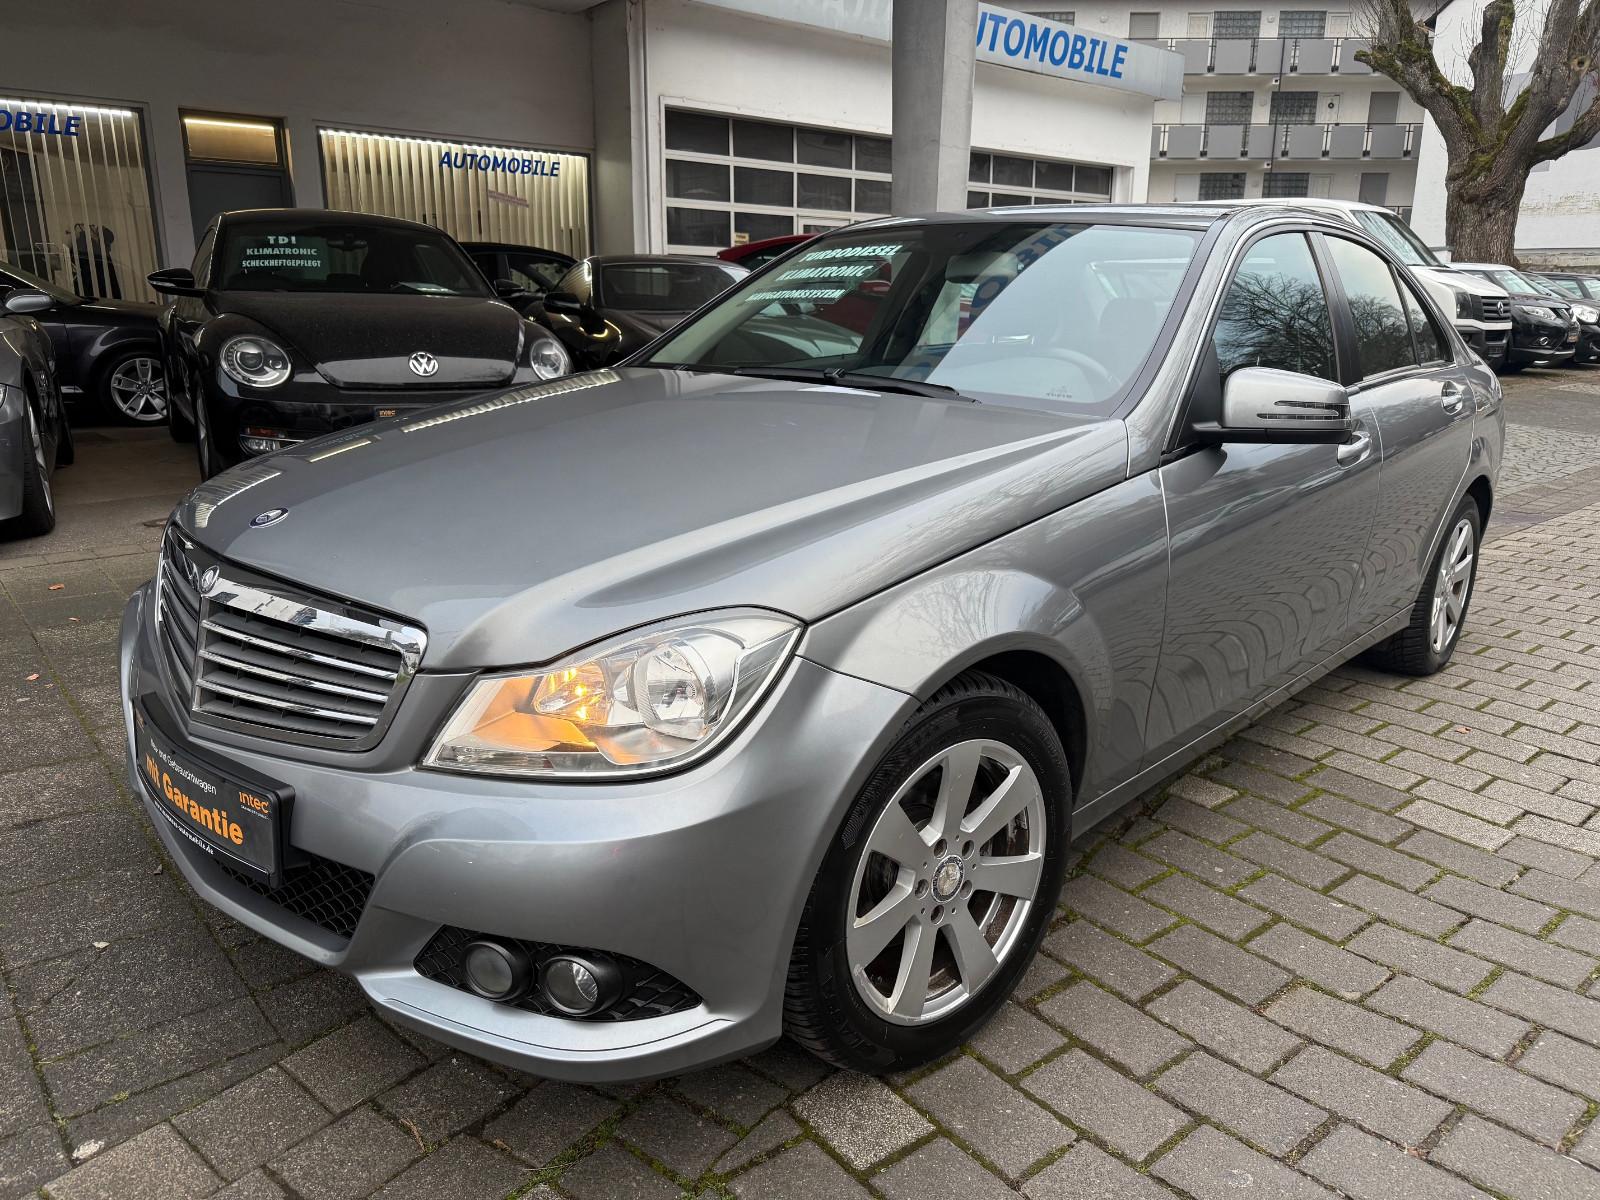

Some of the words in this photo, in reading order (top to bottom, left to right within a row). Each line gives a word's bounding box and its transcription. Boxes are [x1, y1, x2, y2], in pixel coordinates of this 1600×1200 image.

[0, 113, 80, 136] OBILE
[440, 151, 560, 177] AUTOMOBILE
[267, 236, 296, 245] TDI
[246, 248, 318, 256] KLIMATRONIC
[799, 244, 903, 263] TURBODIESEL
[242, 259, 321, 267] SCHECKHEFTGEPFLEGT
[775, 265, 874, 283] KLIMATRONIC
[744, 289, 846, 303] NAVIGATIONSSYSTEM
[146, 753, 161, 789] mit
[162, 772, 244, 845] Garantie
